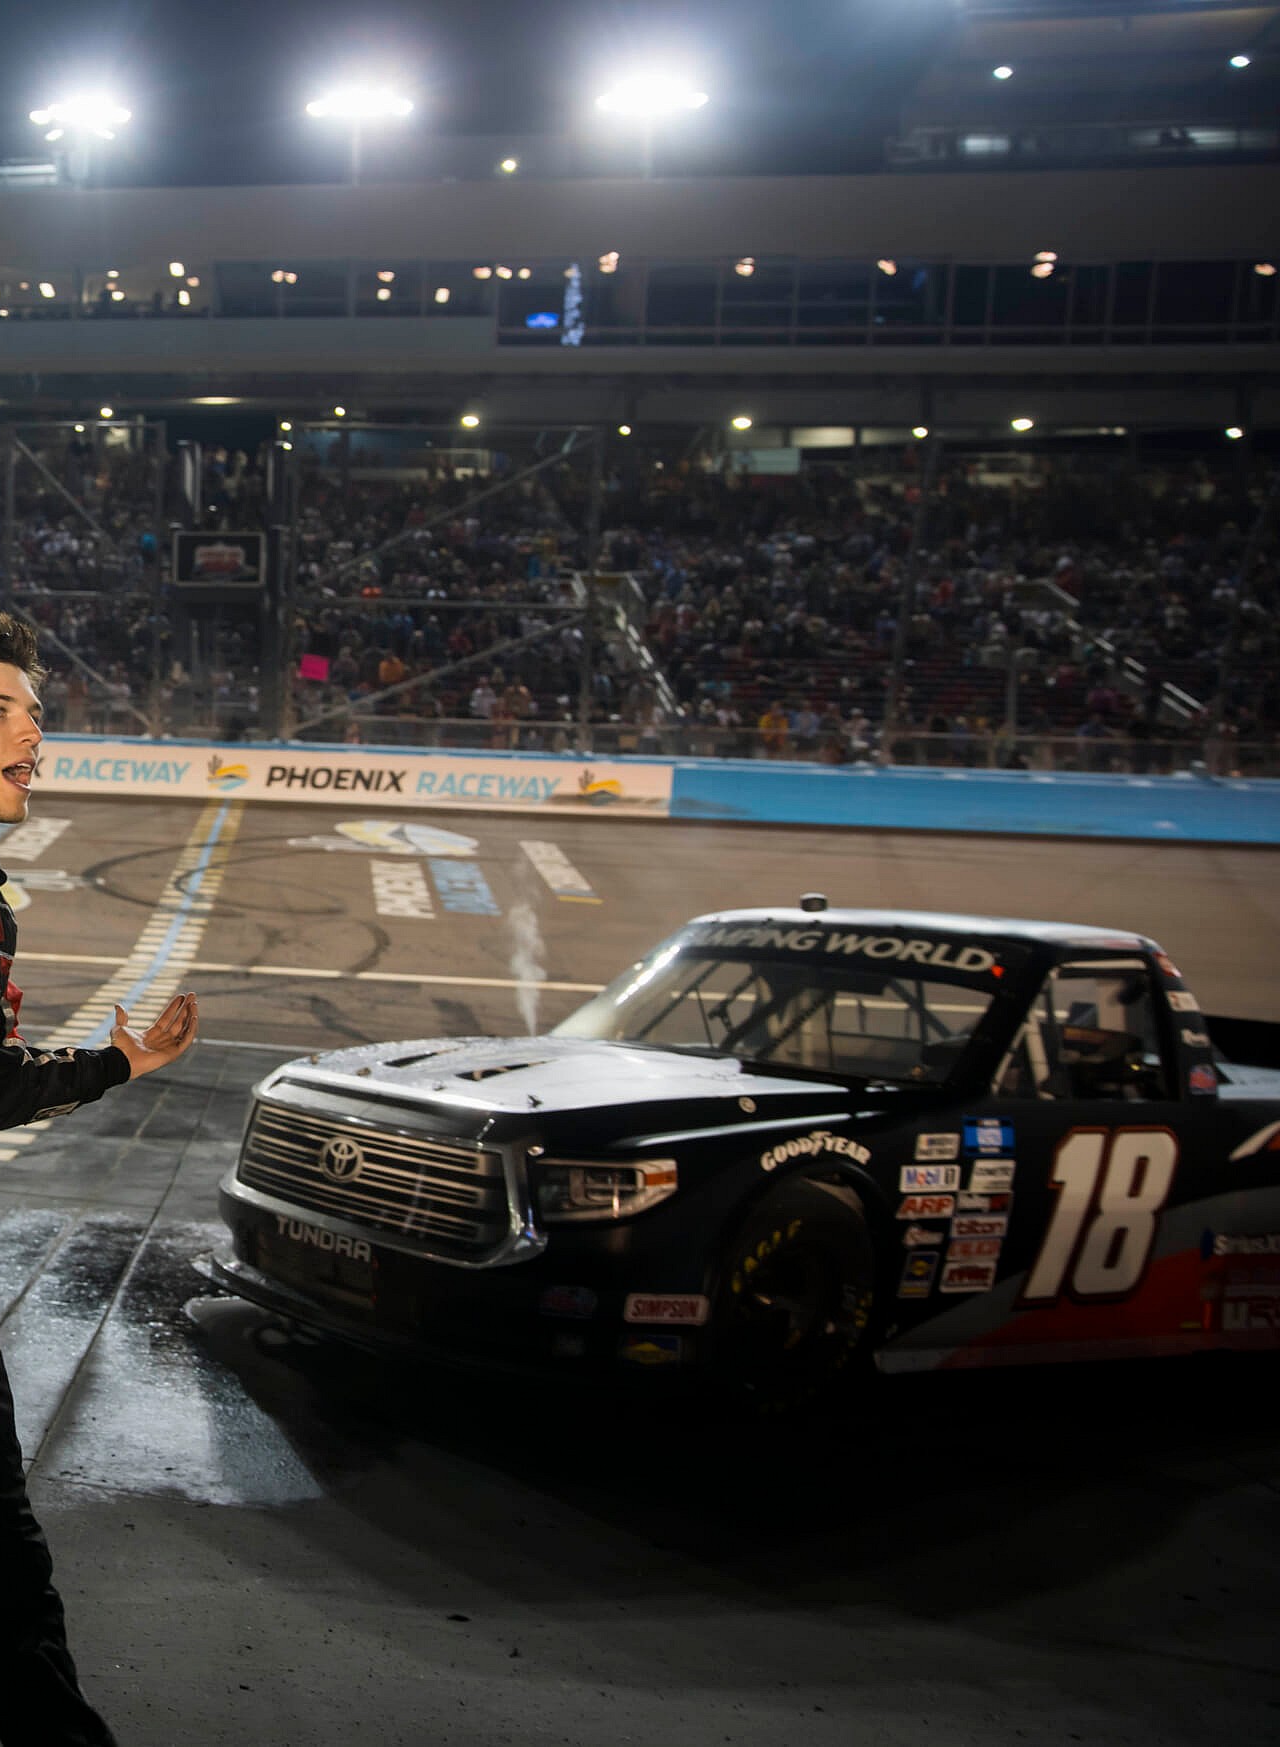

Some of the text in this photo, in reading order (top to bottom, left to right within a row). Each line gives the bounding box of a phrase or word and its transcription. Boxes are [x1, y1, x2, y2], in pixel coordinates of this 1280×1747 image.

[53, 757, 192, 784] RACEWAY
[266, 766, 562, 801] PHOENIX RACEWAY
[824, 931, 996, 973] WORLD
[901, 1196, 952, 1214] ARP
[1020, 1127, 1179, 1302] 18
[275, 1214, 372, 1263] TUNDRA
[631, 1299, 701, 1318] SIMPSON
